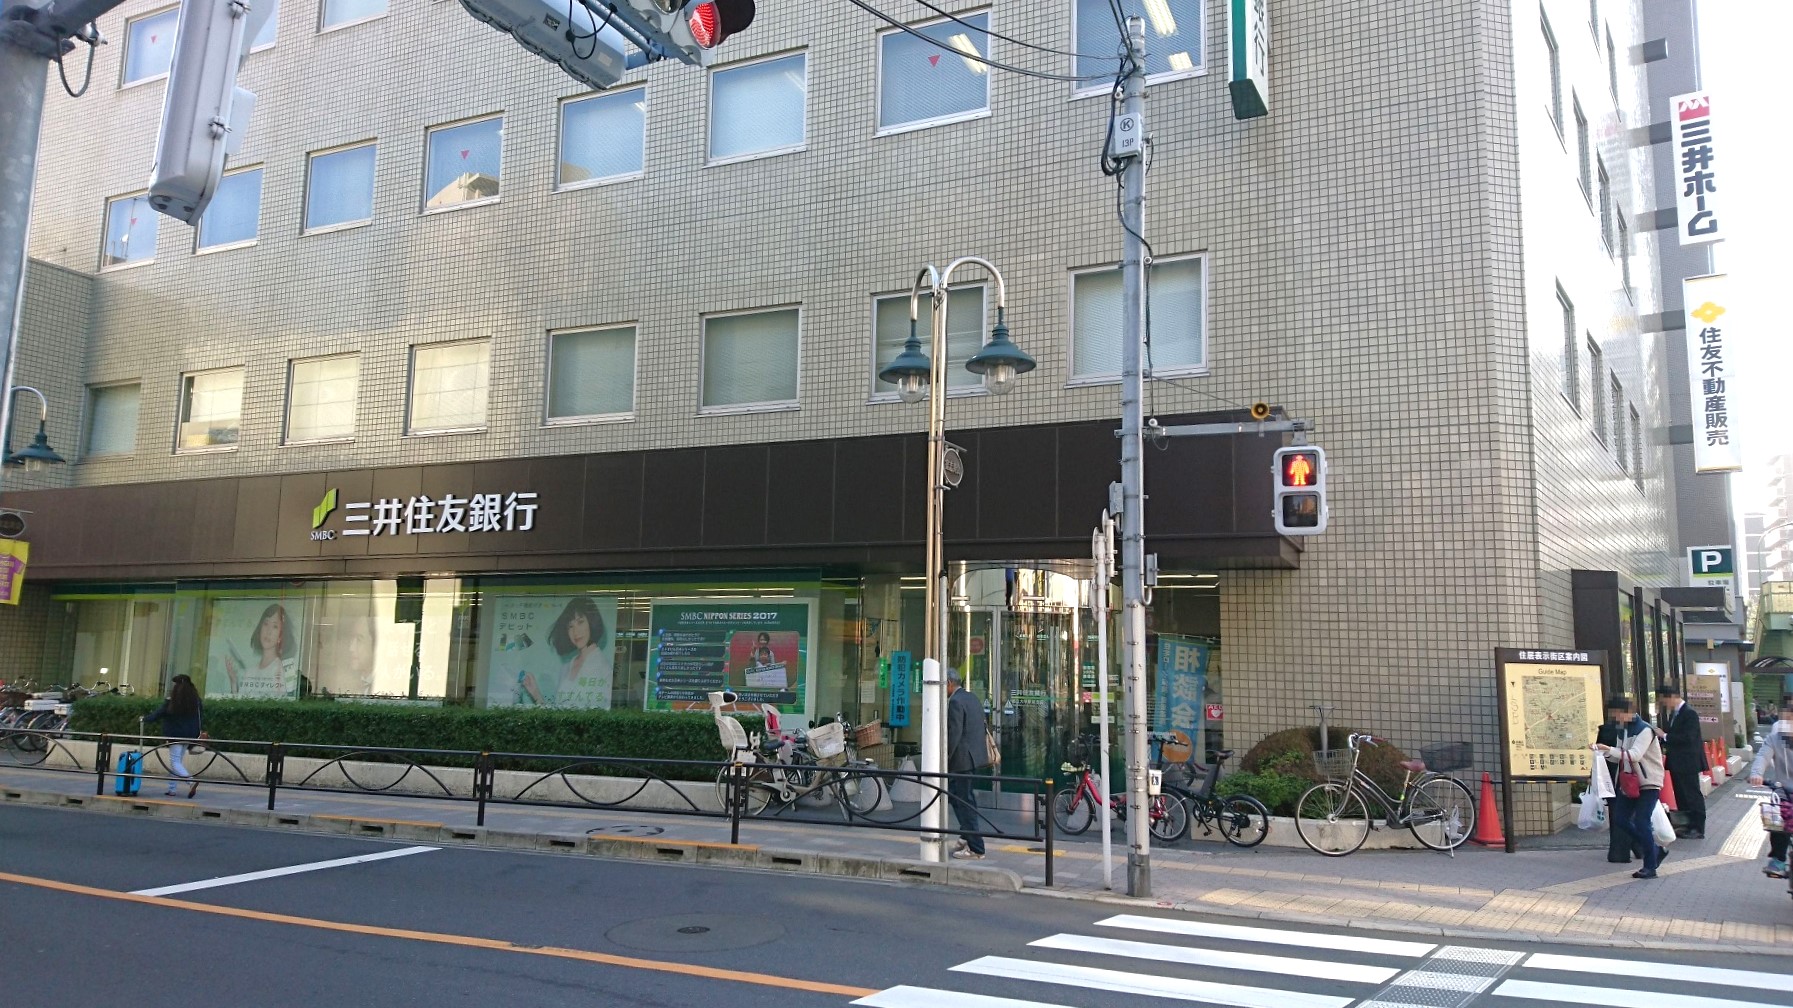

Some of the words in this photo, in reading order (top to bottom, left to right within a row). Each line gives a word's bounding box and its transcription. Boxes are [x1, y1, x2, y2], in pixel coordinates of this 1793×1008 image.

[1122, 138, 1134, 148] 13P
[1680, 119, 1718, 236] 三井ホーム
[1699, 327, 1729, 446] 住友不動産販売
[342, 491, 538, 536] 三井住友銀行
[310, 530, 334, 540] SMBC
[1701, 550, 1722, 572] P
[502, 612, 534, 620] SMBC
[680, 612, 703, 620] SMBC
[703, 612, 728, 620] NIPPON
[729, 612, 752, 620] SERIES
[753, 612, 777, 620] 2017
[499, 622, 533, 630] デビット
[1519, 651, 1588, 661] 住居表示街区案内図
[896, 655, 906, 722] 防犯カメラ作動中
